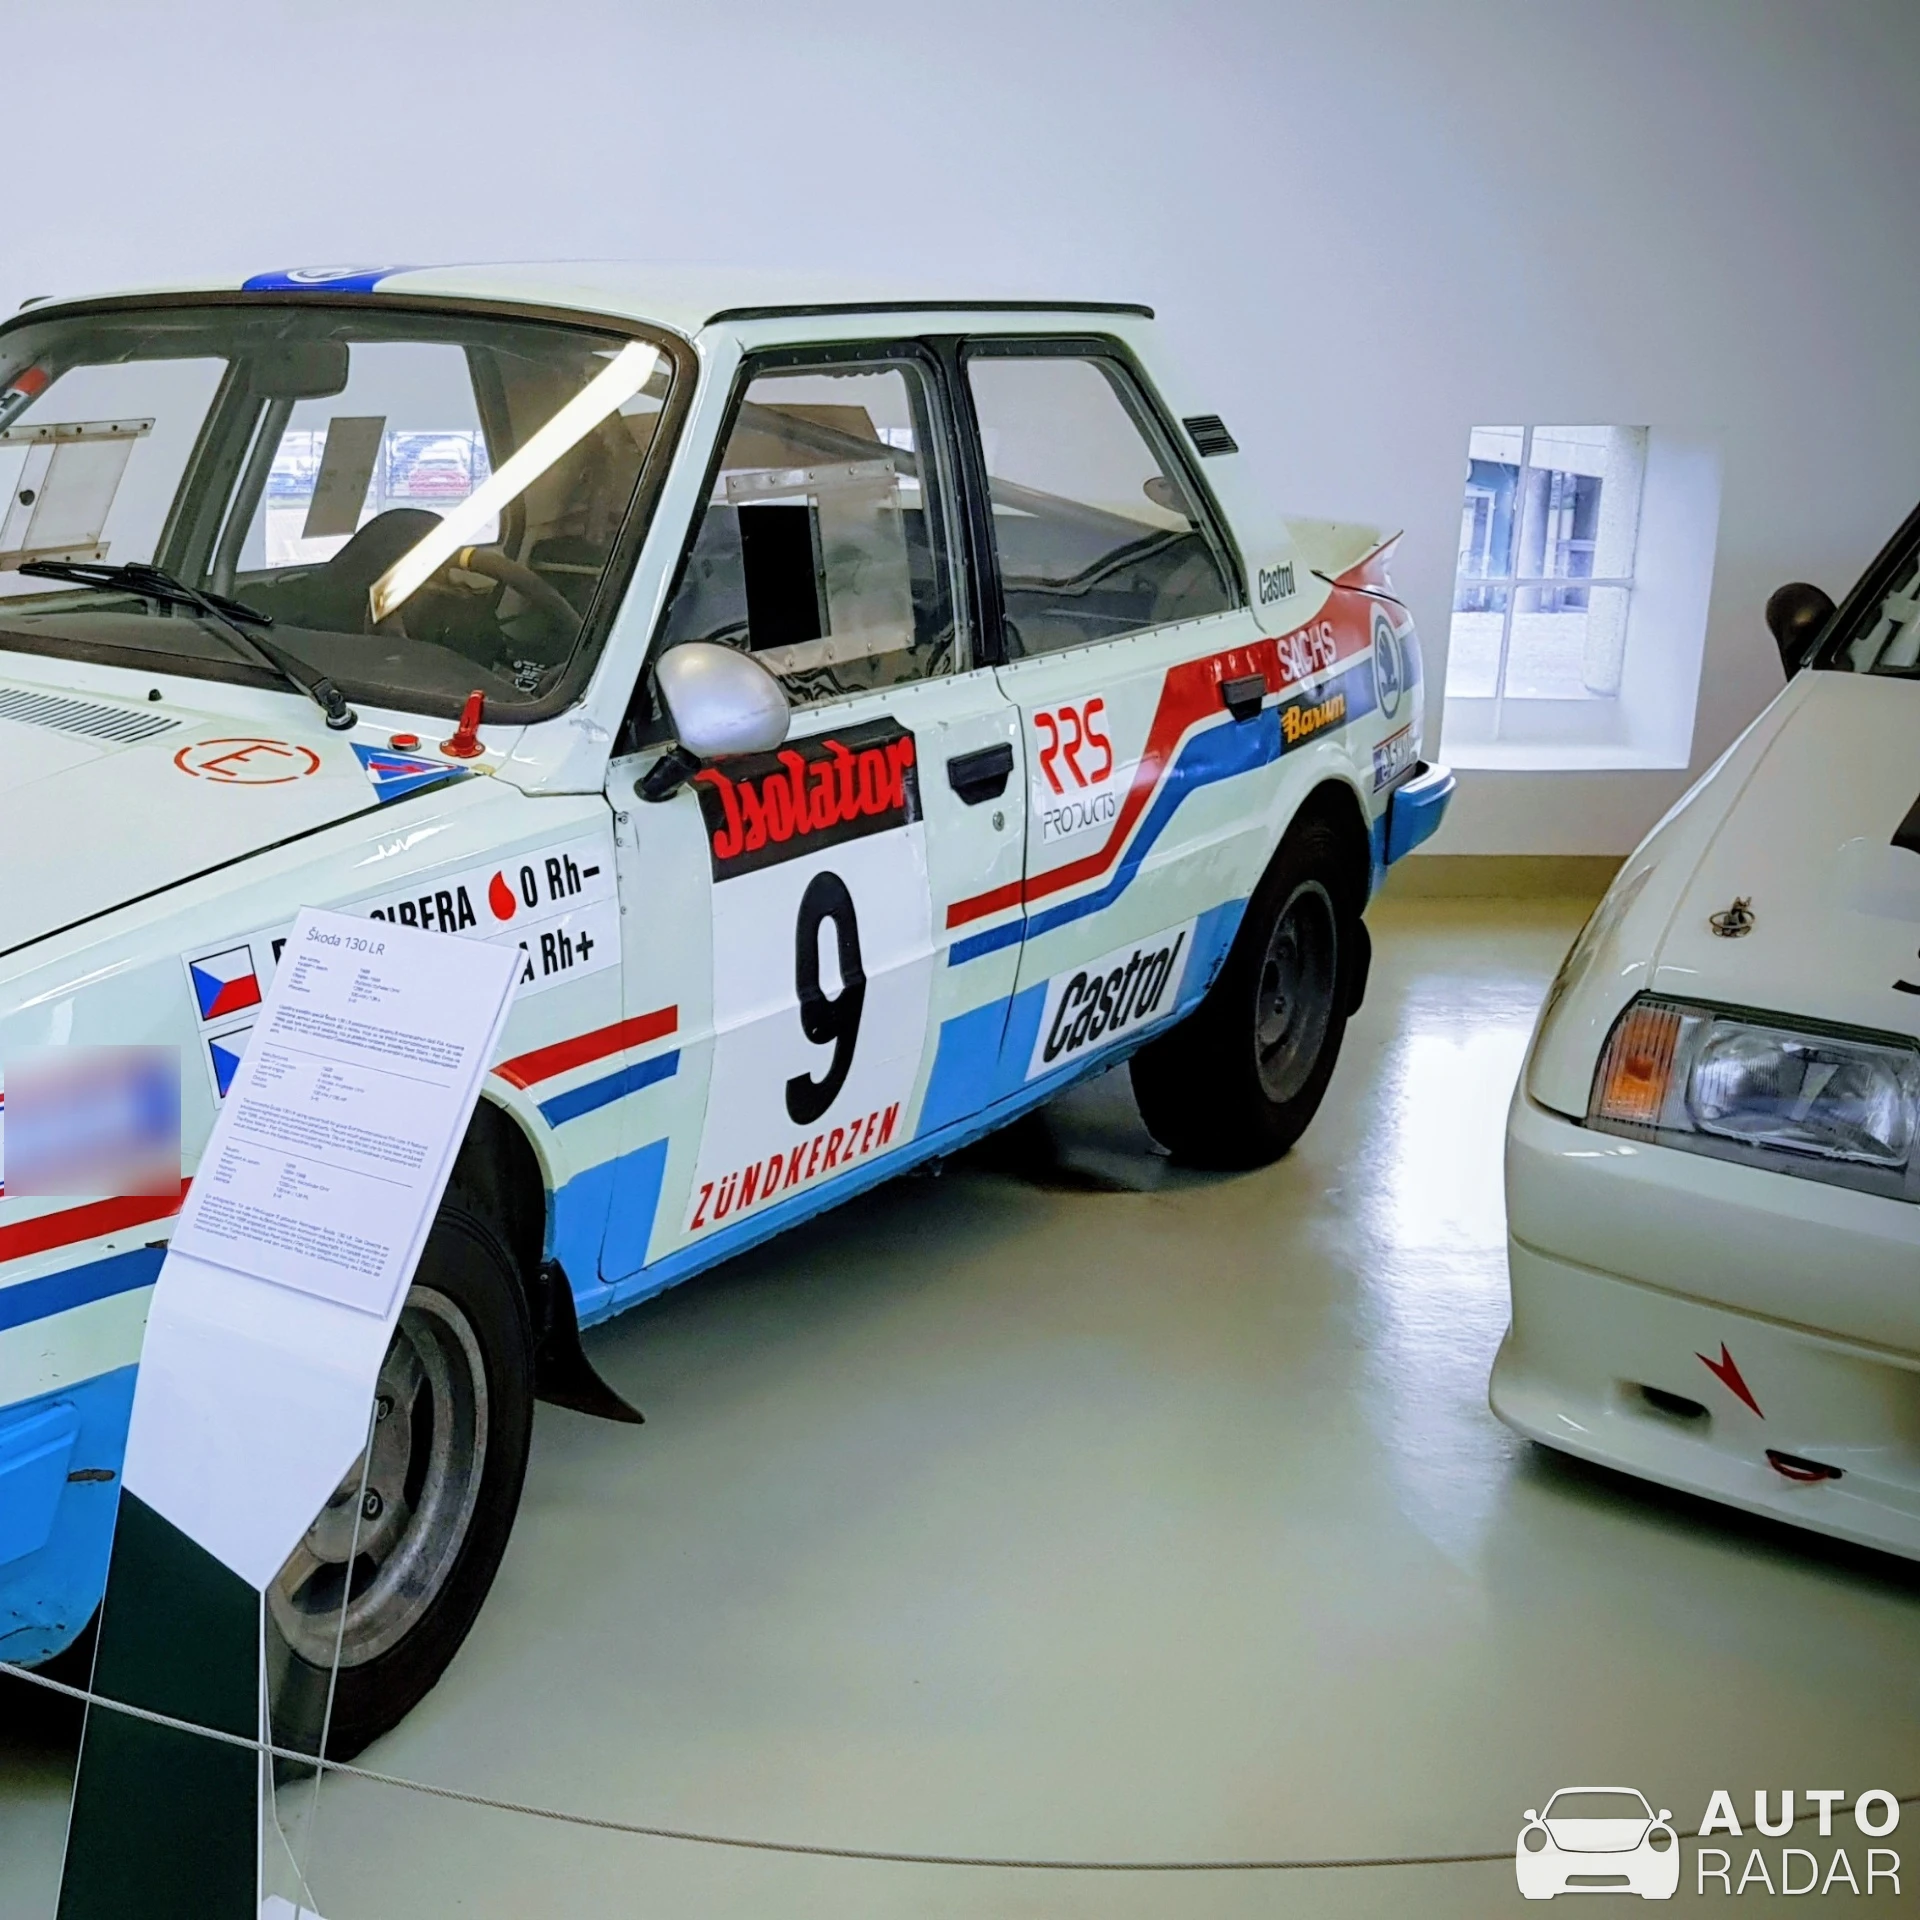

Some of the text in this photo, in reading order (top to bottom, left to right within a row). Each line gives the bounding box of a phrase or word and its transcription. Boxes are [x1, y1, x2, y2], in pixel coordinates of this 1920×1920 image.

[1258, 561, 1296, 605] Castrol
[1277, 621, 1337, 682] SACHS
[1281, 694, 1346, 743] Barum
[1044, 792, 1115, 839] PRODUCTS
[306, 927, 386, 956] Škoda 130 LR
[540, 929, 595, 976] Rh+
[786, 871, 867, 1125] 9
[1043, 932, 1186, 1063] Castrol
[690, 1102, 900, 1231] ZÜNDKERZEN
